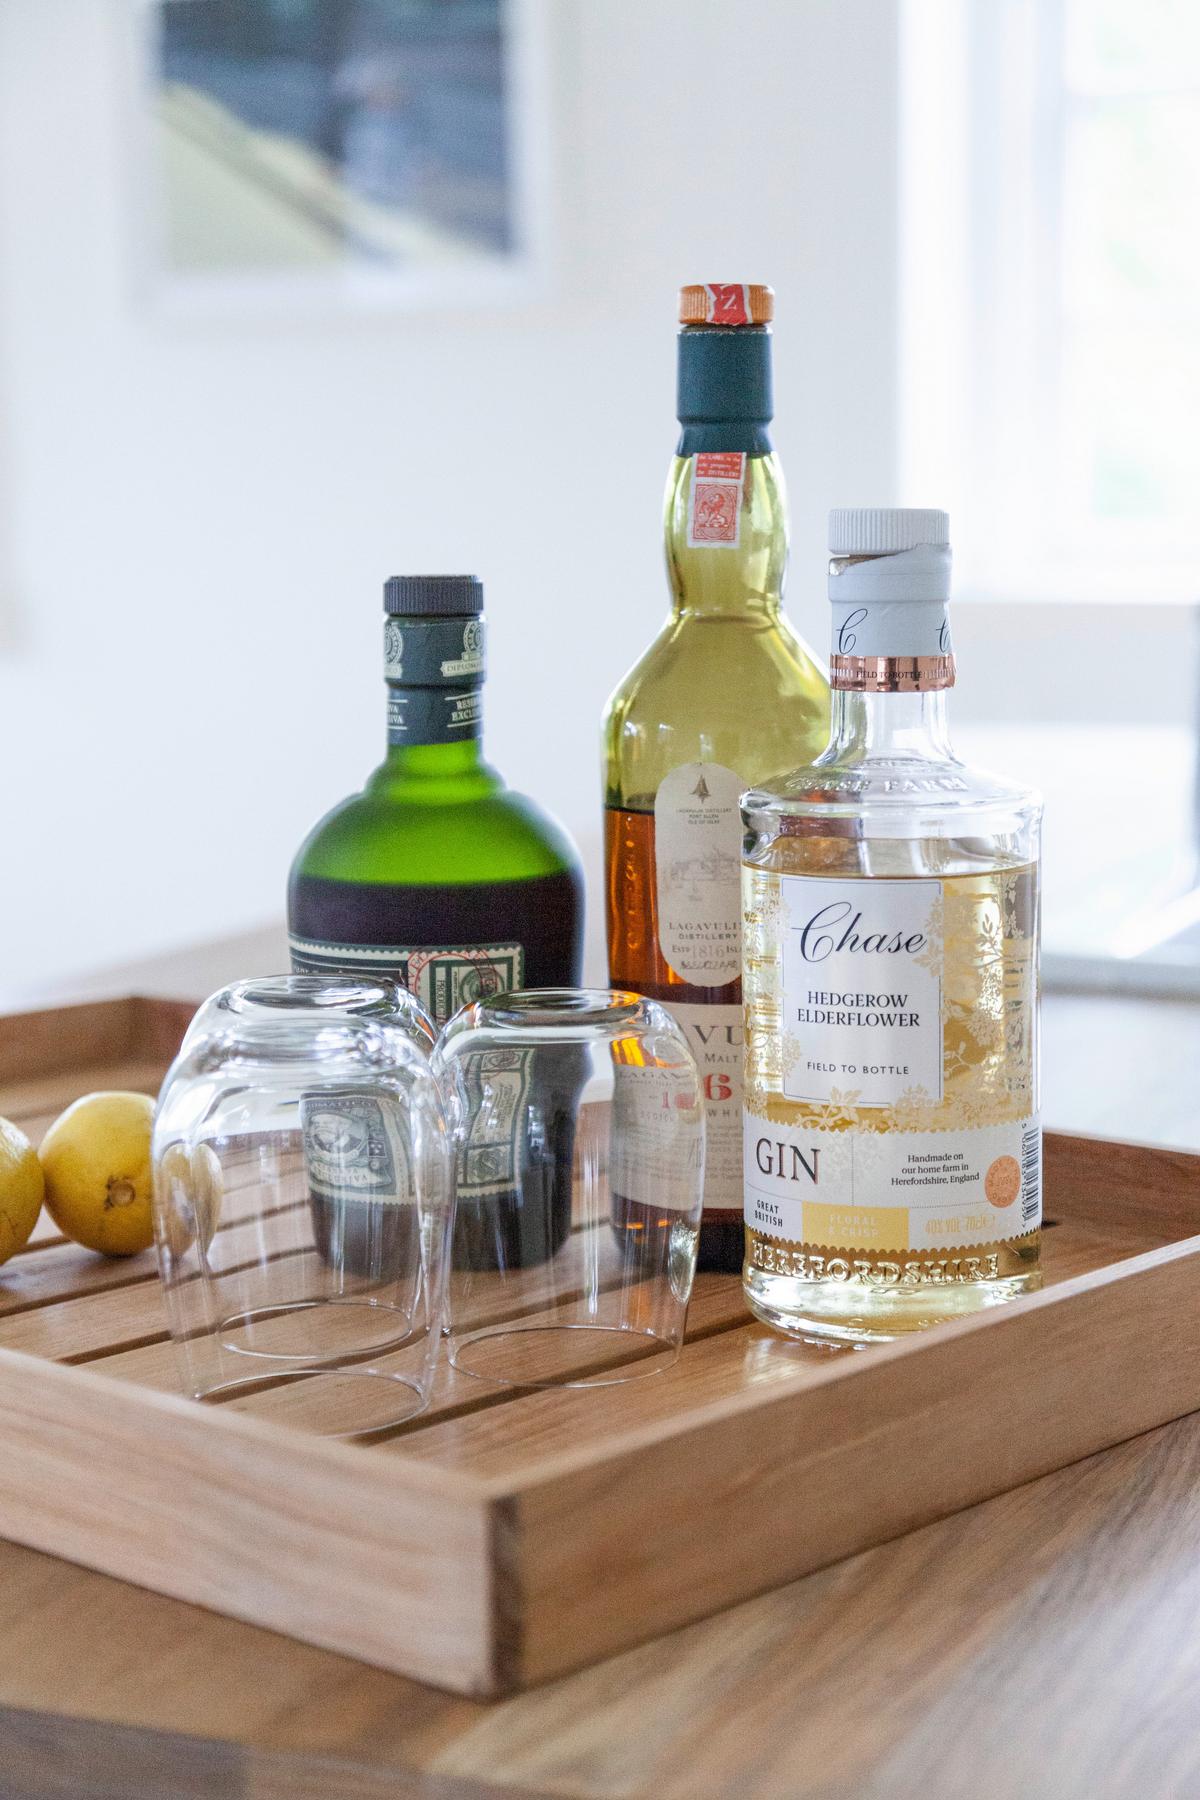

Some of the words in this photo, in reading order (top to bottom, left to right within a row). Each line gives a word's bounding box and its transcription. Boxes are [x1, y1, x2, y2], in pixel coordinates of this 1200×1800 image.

[679, 933, 738, 941] DISTILLERY
[791, 901, 928, 963] Chase
[807, 990, 908, 1008] HEDGEROW
[797, 1008, 921, 1028] ELDERFLOWER
[806, 1061, 836, 1073] FIELD
[840, 1063, 857, 1074] TO
[862, 1064, 910, 1076] BOTTLE
[756, 1137, 821, 1185] GIN
[907, 1154, 952, 1164] Handmade
[953, 1153, 964, 1161] on
[901, 1166, 916, 1175] our
[917, 1164, 942, 1174] home
[942, 1163, 960, 1173] farm
[961, 1163, 969, 1171] in
[891, 1175, 949, 1187] Herefordshire,
[950, 1172, 980, 1185] England
[757, 1200, 779, 1215] GREAT
[755, 1210, 783, 1228] BRITISH
